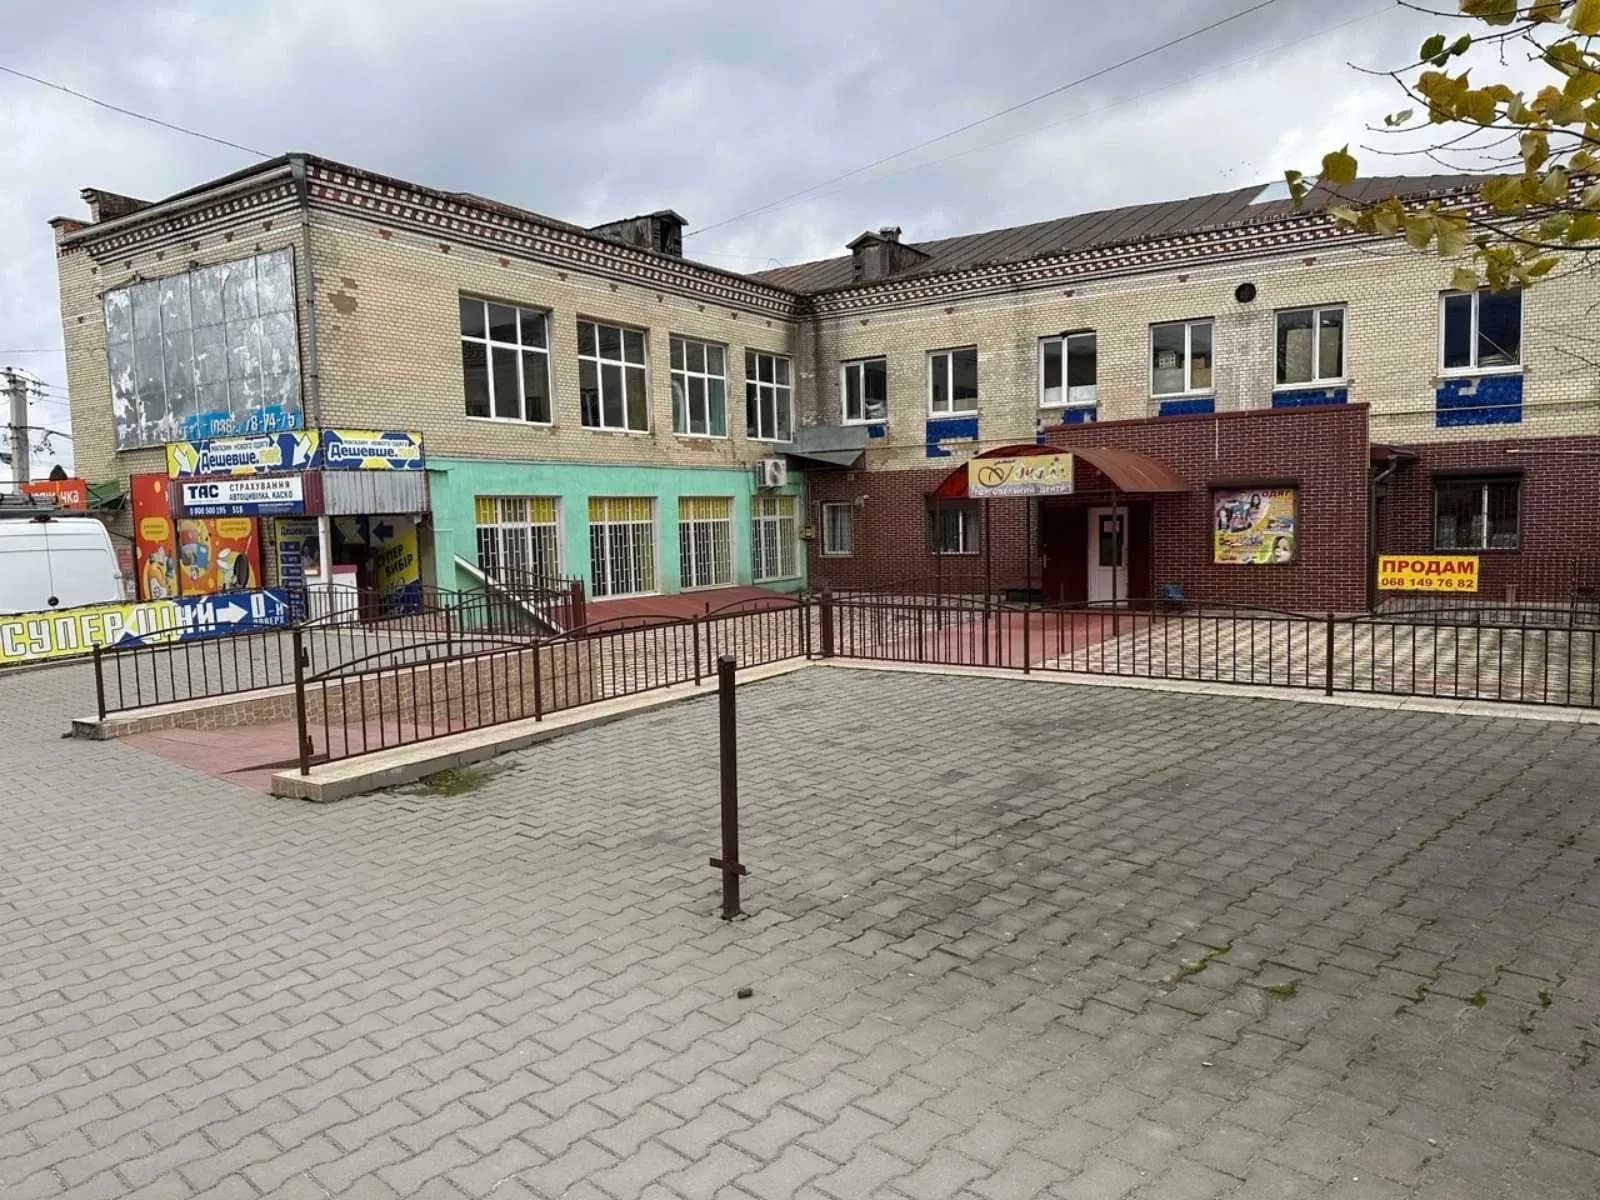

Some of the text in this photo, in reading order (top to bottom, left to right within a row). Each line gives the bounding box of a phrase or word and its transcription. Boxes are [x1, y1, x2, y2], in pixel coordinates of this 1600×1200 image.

[187, 484, 219, 499] ТАС
[229, 480, 290, 492] СТРАХУВАННЯ
[272, 490, 293, 500] КАСКО
[1382, 560, 1474, 576] ПРОДАМ
[1382, 577, 1474, 588] 068 149 76 82
[0, 602, 216, 658] СУПЕР ЦІНИ
